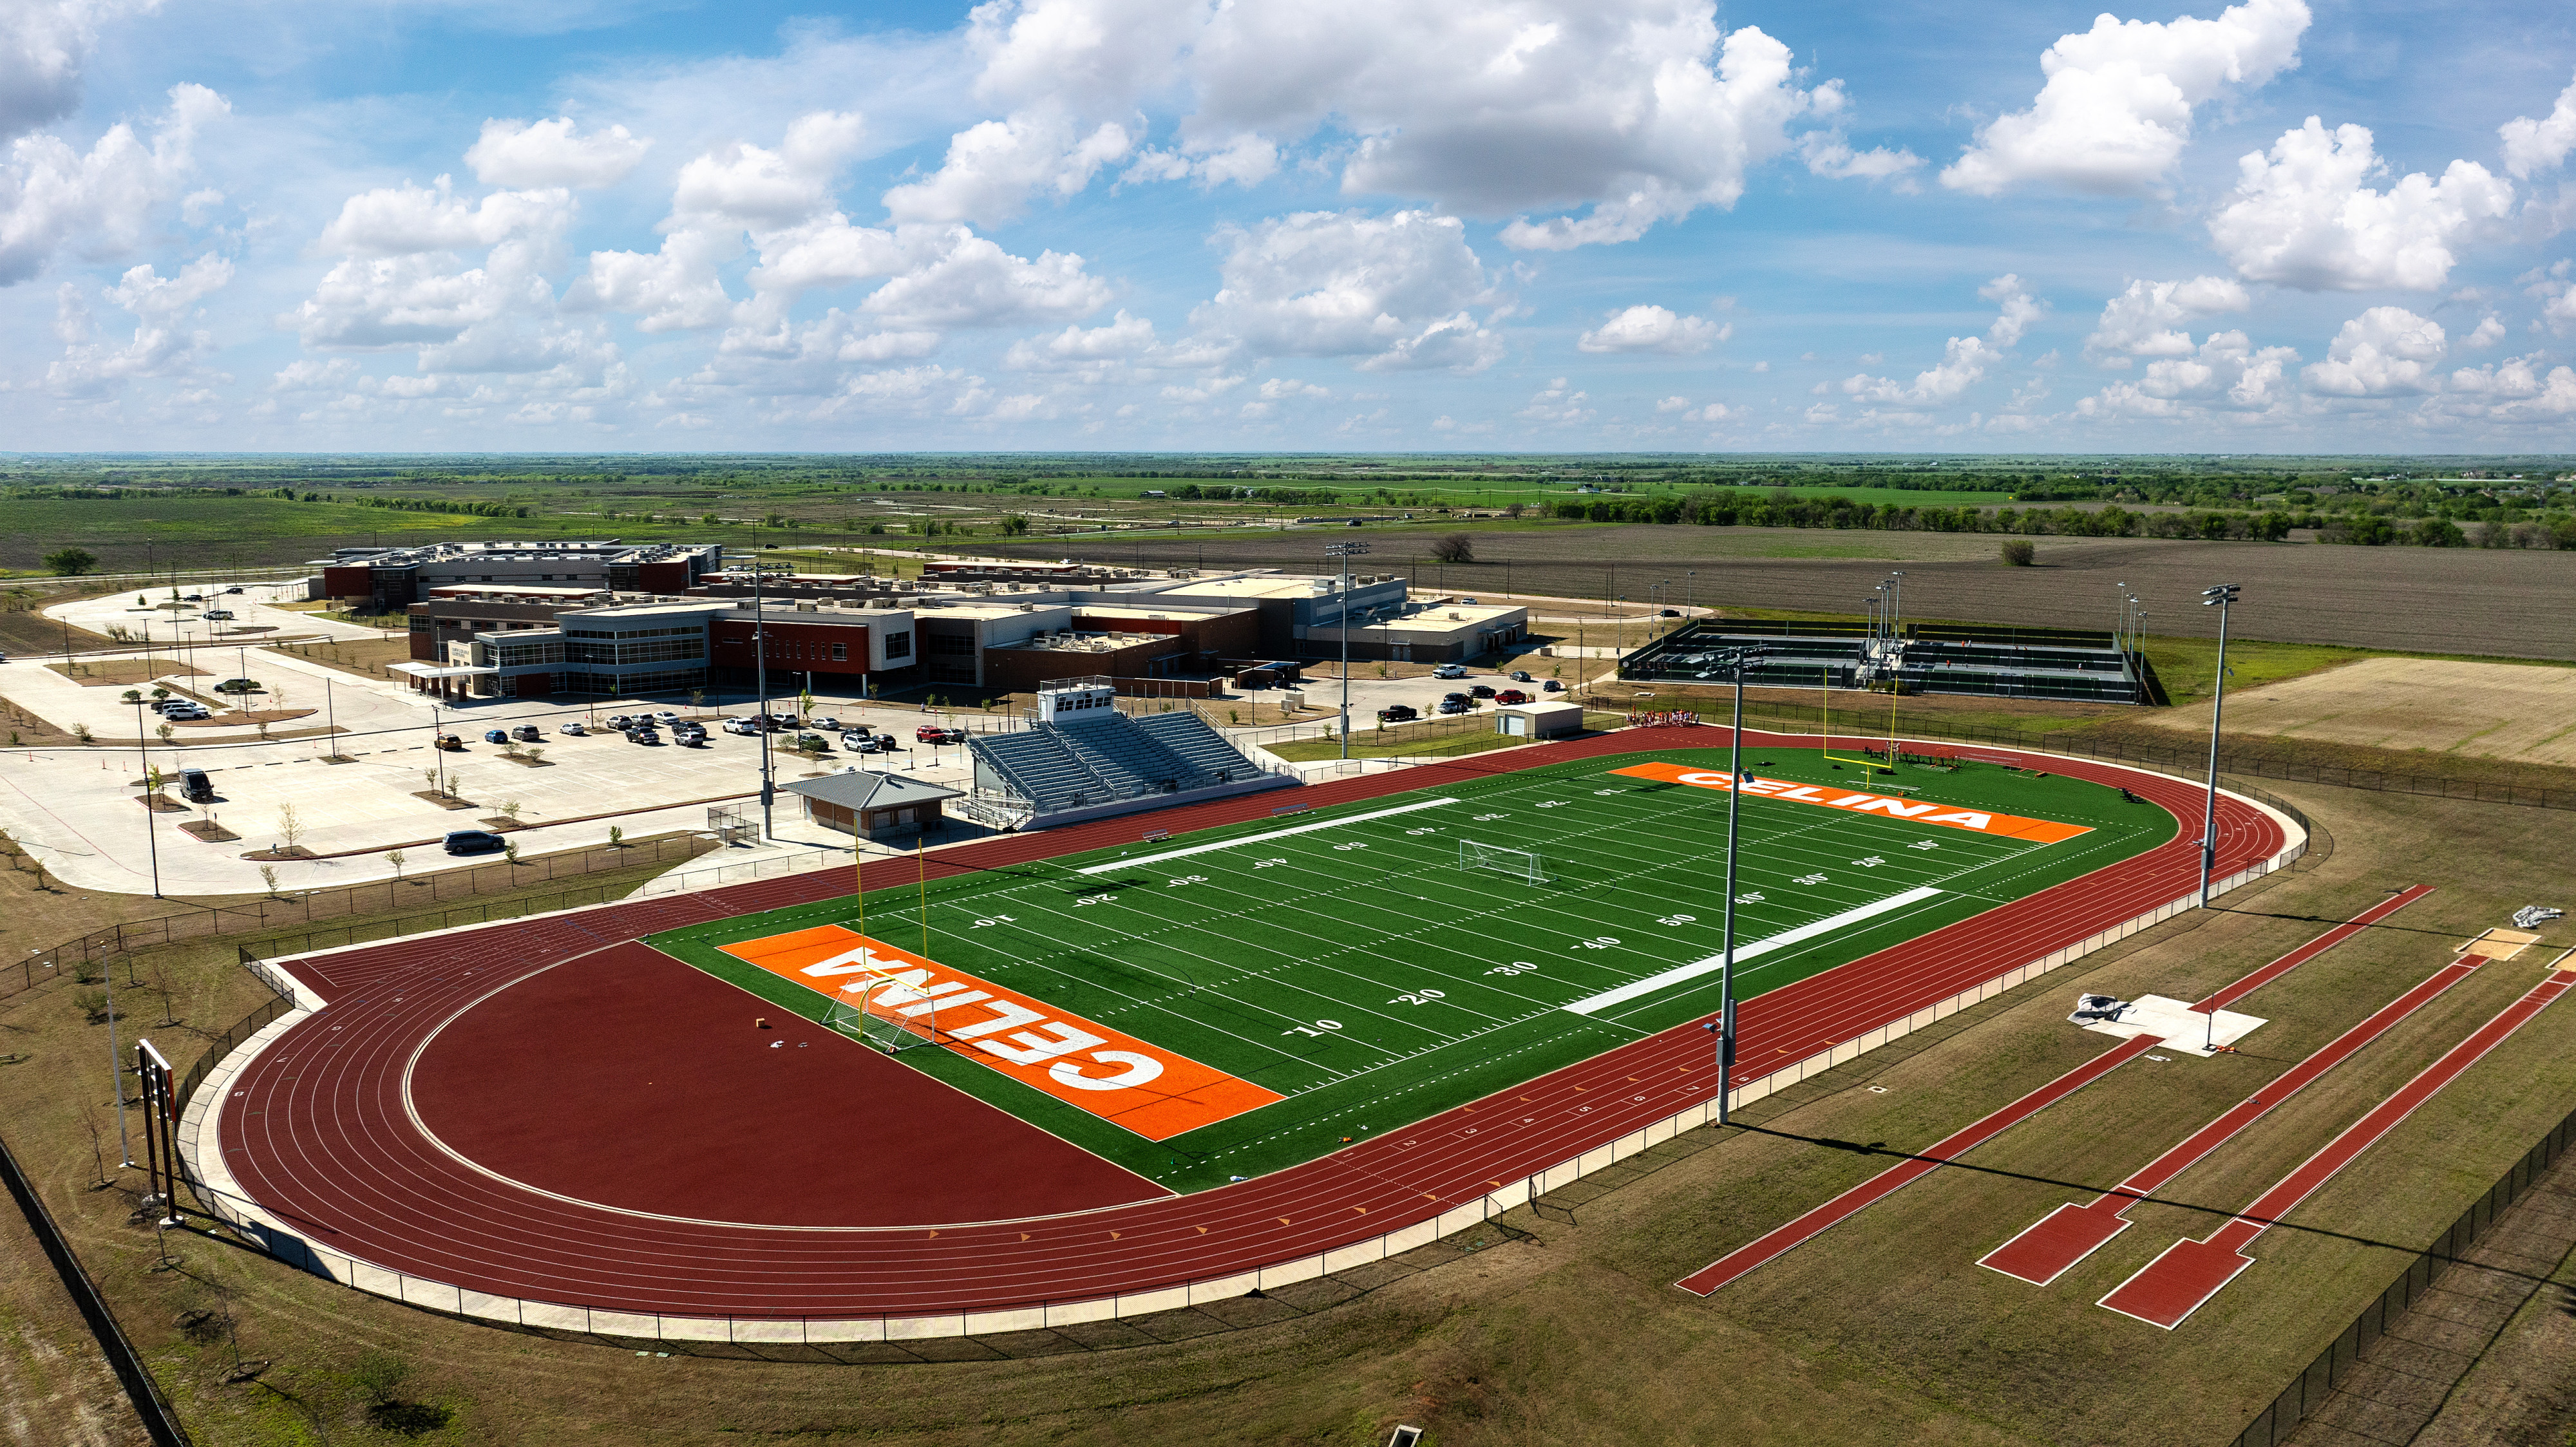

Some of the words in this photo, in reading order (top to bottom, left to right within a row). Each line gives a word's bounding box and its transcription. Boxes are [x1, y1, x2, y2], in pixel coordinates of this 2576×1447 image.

[1678, 773, 1992, 829] CELINA
[1907, 840, 1940, 851] 10
[1255, 858, 1287, 867] 40
[1851, 857, 1886, 867] 20
[1170, 875, 1208, 886] 30
[1792, 874, 1829, 885] 30
[1077, 893, 1118, 905] 20
[1734, 893, 1765, 905] 40
[974, 914, 1018, 927] 10
[1656, 914, 1696, 926] 50
[1582, 937, 1621, 949] 40
[1493, 961, 1538, 976] 30
[1397, 989, 1446, 1005] 20
[799, 947, 1164, 1091] CELINA
[1293, 1019, 1343, 1037] 10
